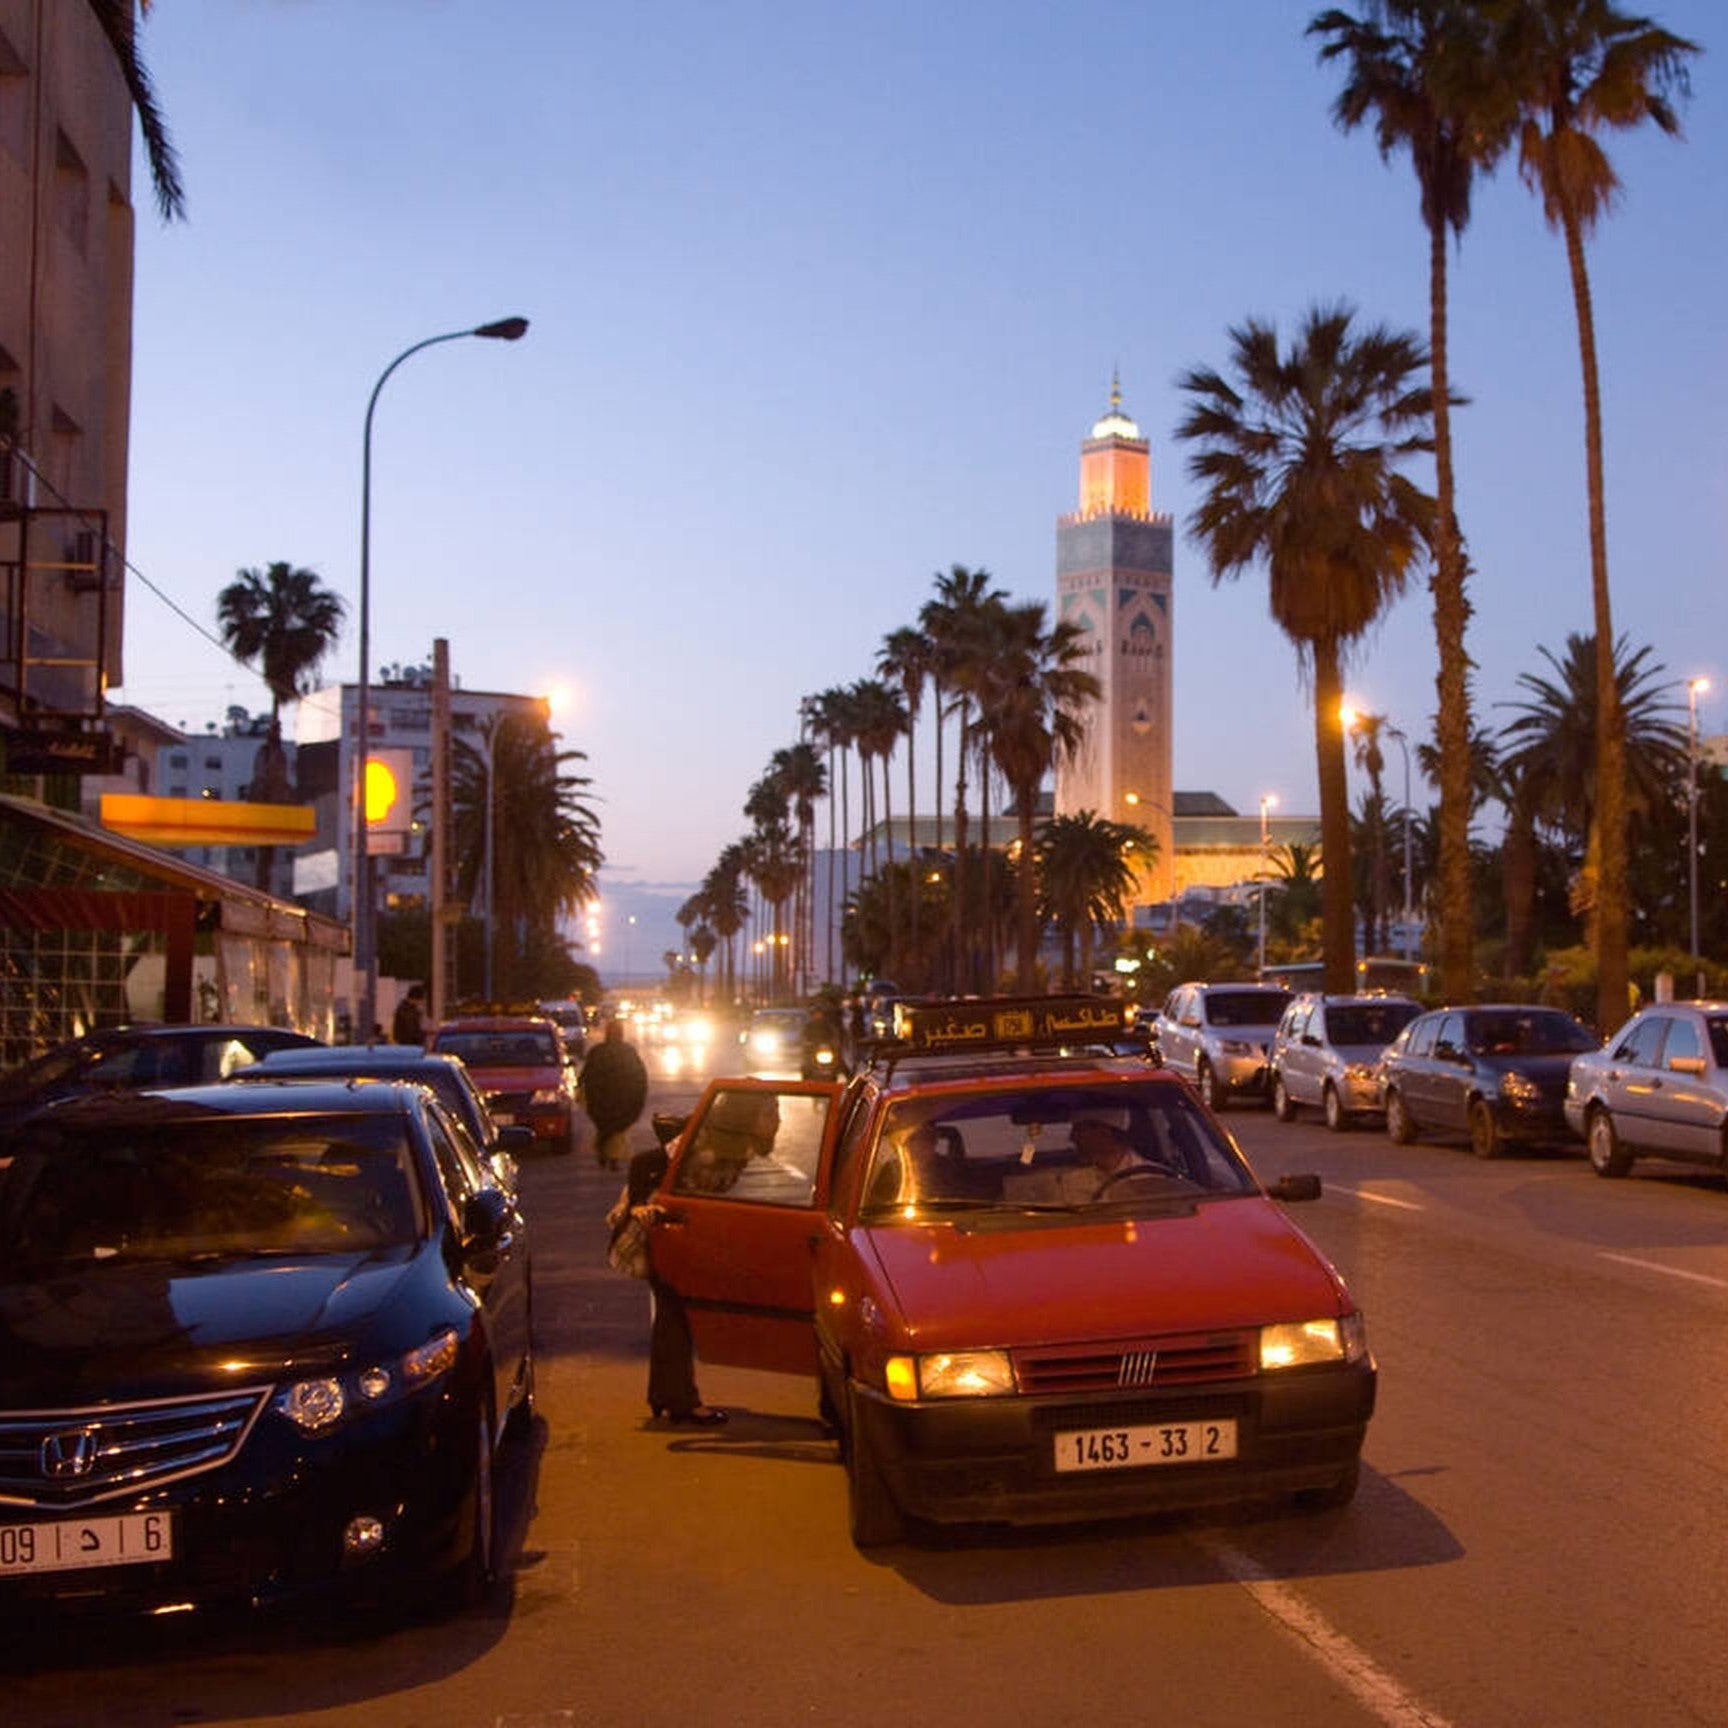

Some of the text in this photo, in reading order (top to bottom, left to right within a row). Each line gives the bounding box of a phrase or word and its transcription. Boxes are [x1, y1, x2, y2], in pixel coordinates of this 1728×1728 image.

[1076, 1433, 1130, 1464] 1463
[1160, 1428, 1188, 1456] 33
[1206, 1426, 1220, 1454] 2
[145, 1516, 161, 1551] 6
